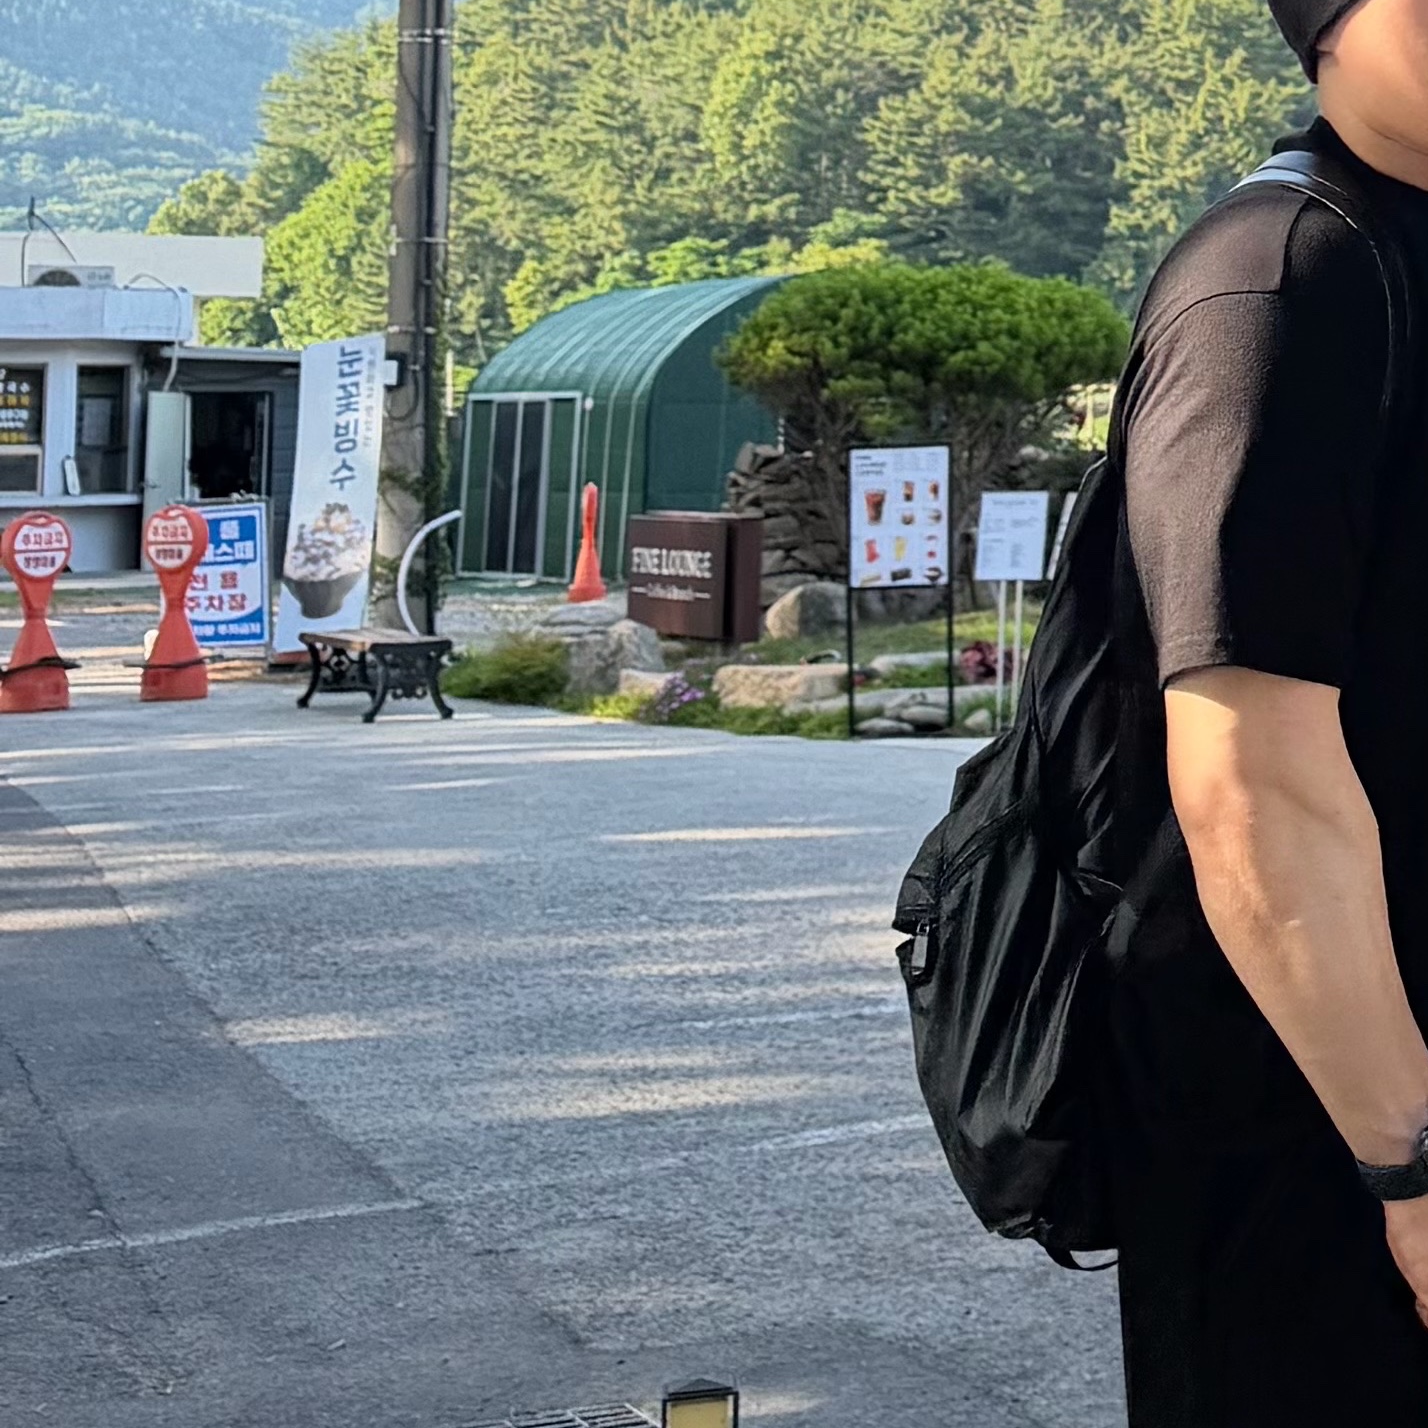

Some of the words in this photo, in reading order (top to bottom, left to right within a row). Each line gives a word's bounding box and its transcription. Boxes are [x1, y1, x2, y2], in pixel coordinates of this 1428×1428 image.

[329, 345, 363, 491] 눈꽃빙수
[22, 531, 63, 546] 주차금지
[153, 524, 188, 538] 주차금지
[186, 593, 247, 612] 주차장
